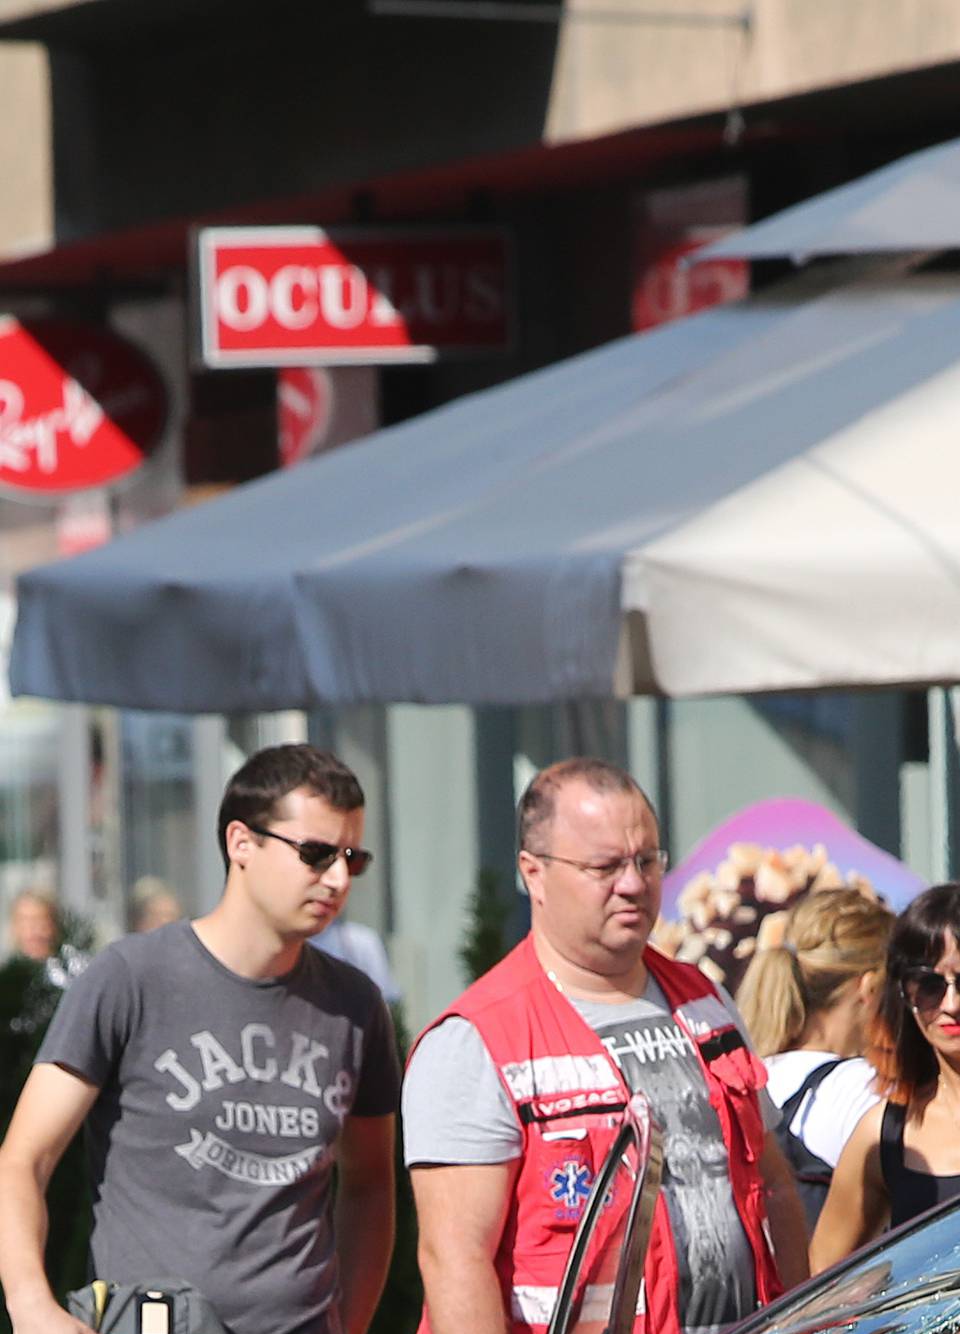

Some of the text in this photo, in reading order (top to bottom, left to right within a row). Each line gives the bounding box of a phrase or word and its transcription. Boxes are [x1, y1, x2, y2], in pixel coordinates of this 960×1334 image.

[217, 264, 497, 331] OCULUS
[154, 1023, 328, 1111] JACK
[215, 1101, 319, 1138] JONES
